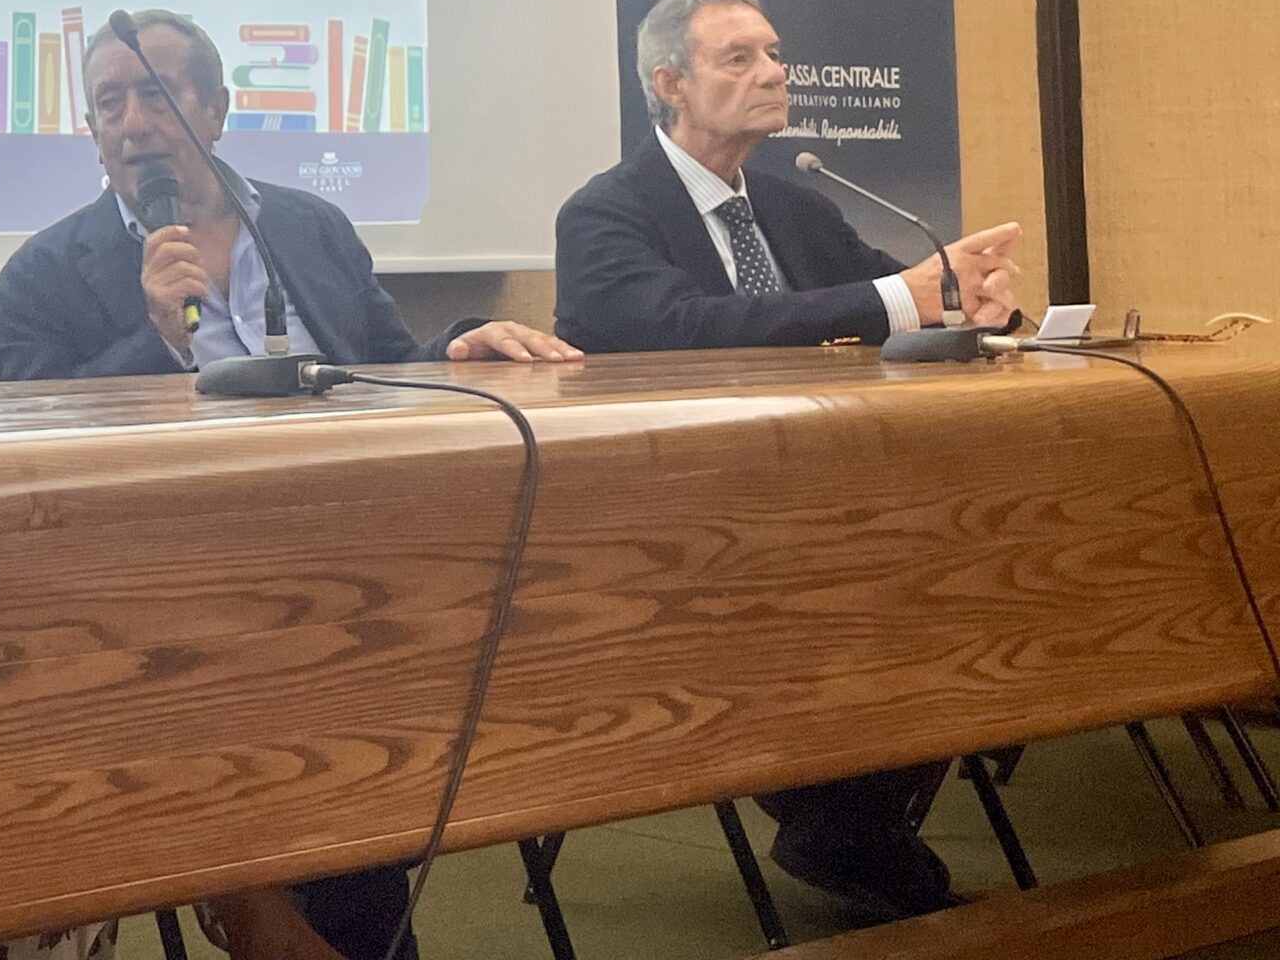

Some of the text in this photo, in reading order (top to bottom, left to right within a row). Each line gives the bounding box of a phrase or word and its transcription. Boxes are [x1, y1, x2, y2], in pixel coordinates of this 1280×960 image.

[821, 65, 900, 88] CENTRALE
[788, 93, 901, 109] OPERATIVO ITALIANO
[821, 118, 902, 147] Responsabili.
